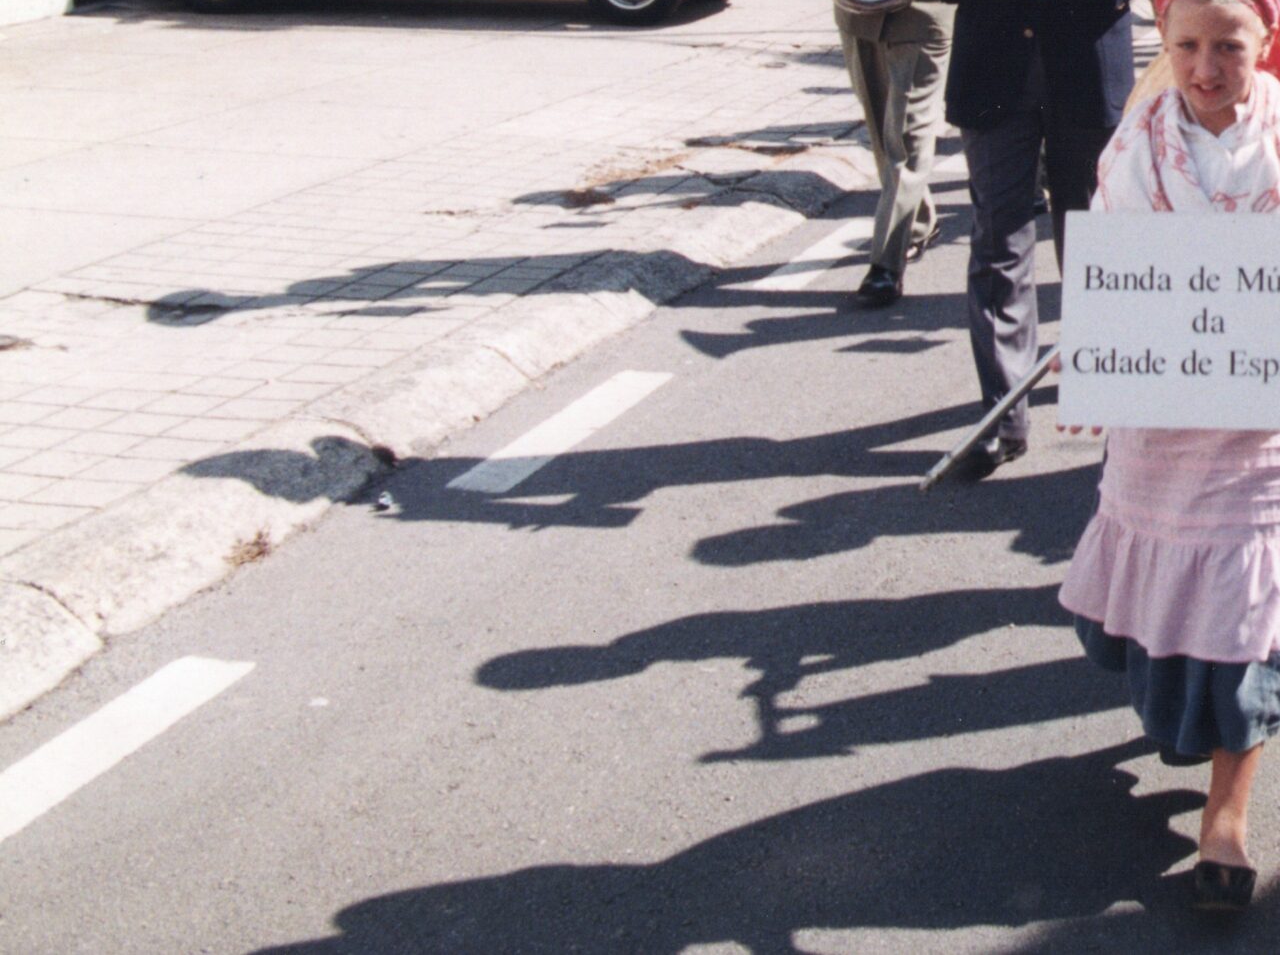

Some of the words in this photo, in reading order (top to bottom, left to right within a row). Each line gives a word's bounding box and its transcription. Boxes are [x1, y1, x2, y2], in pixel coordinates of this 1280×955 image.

[1084, 264, 1172, 291] Banda
[1189, 266, 1221, 292] de
[1192, 308, 1225, 334] da
[1072, 347, 1167, 375] Cidade
[1181, 349, 1213, 376] de
